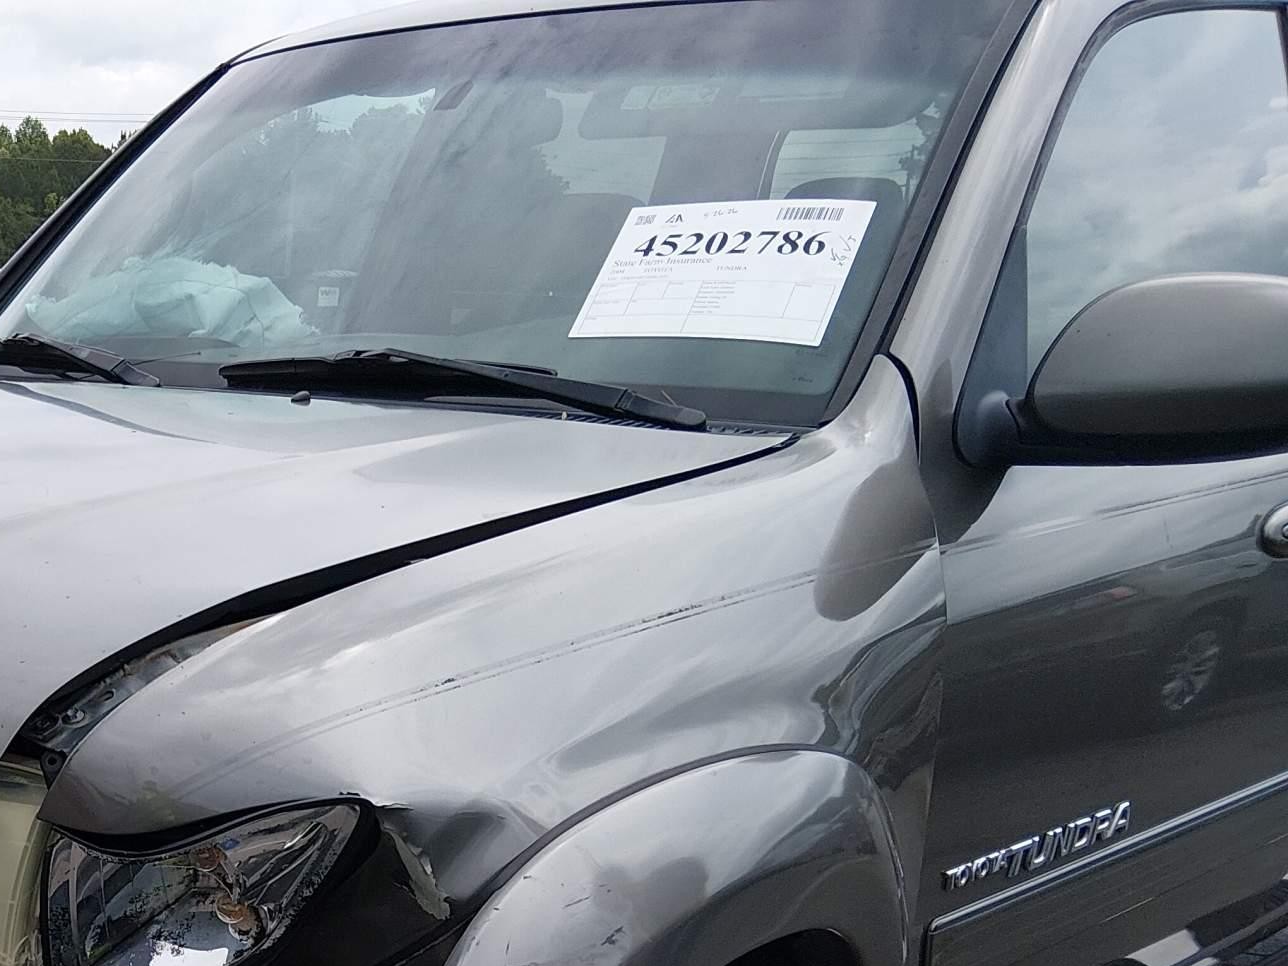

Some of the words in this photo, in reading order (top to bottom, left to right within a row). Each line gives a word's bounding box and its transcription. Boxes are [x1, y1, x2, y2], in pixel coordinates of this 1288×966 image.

[633, 229, 833, 258] 45202786
[665, 256, 713, 265] Insurance
[1003, 800, 1132, 878] TUNDRA
